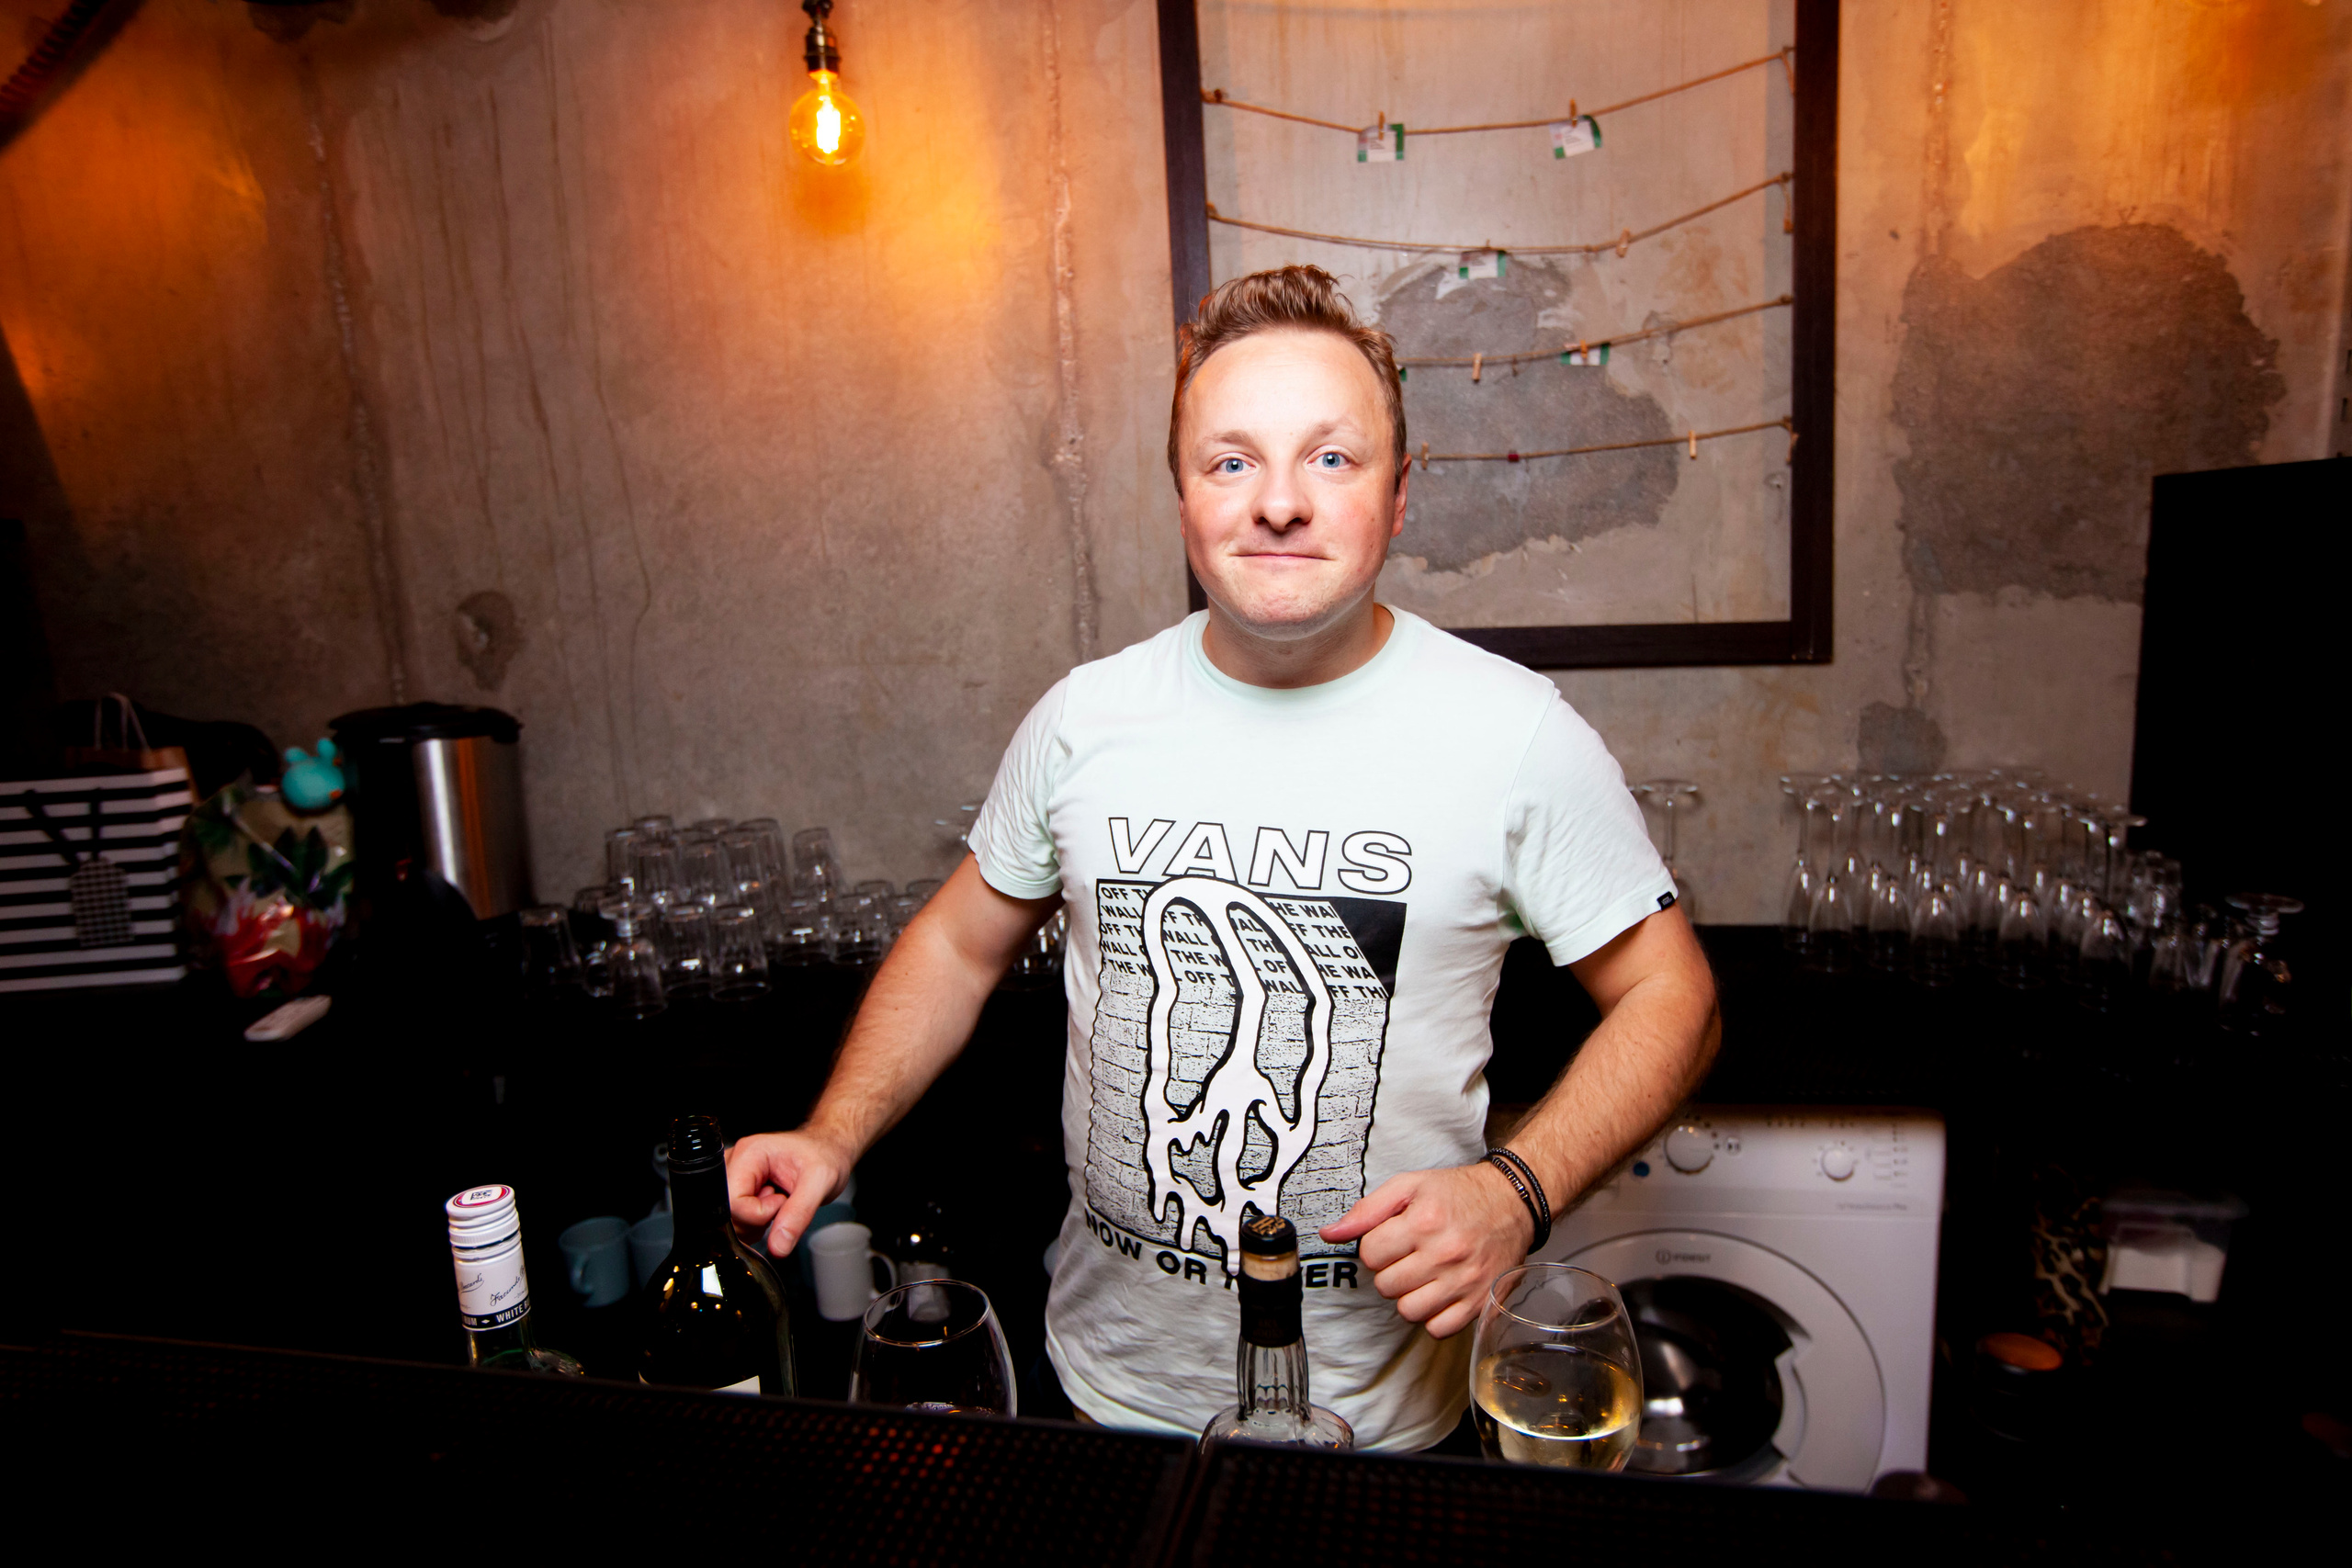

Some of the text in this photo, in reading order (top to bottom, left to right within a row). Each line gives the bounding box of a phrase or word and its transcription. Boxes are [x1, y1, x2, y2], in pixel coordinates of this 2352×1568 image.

[1108, 817, 1412, 895] VANS
[1101, 886, 1128, 900] OFF
[1311, 924, 1351, 940] THE
[1170, 949, 1210, 965] THE
[1107, 959, 1136, 975] THE
[1183, 970, 1217, 986] OFF
[1084, 1207, 1143, 1261] NOW
[1156, 1250, 1207, 1285] OR
[496, 1303, 524, 1323] WHITE
